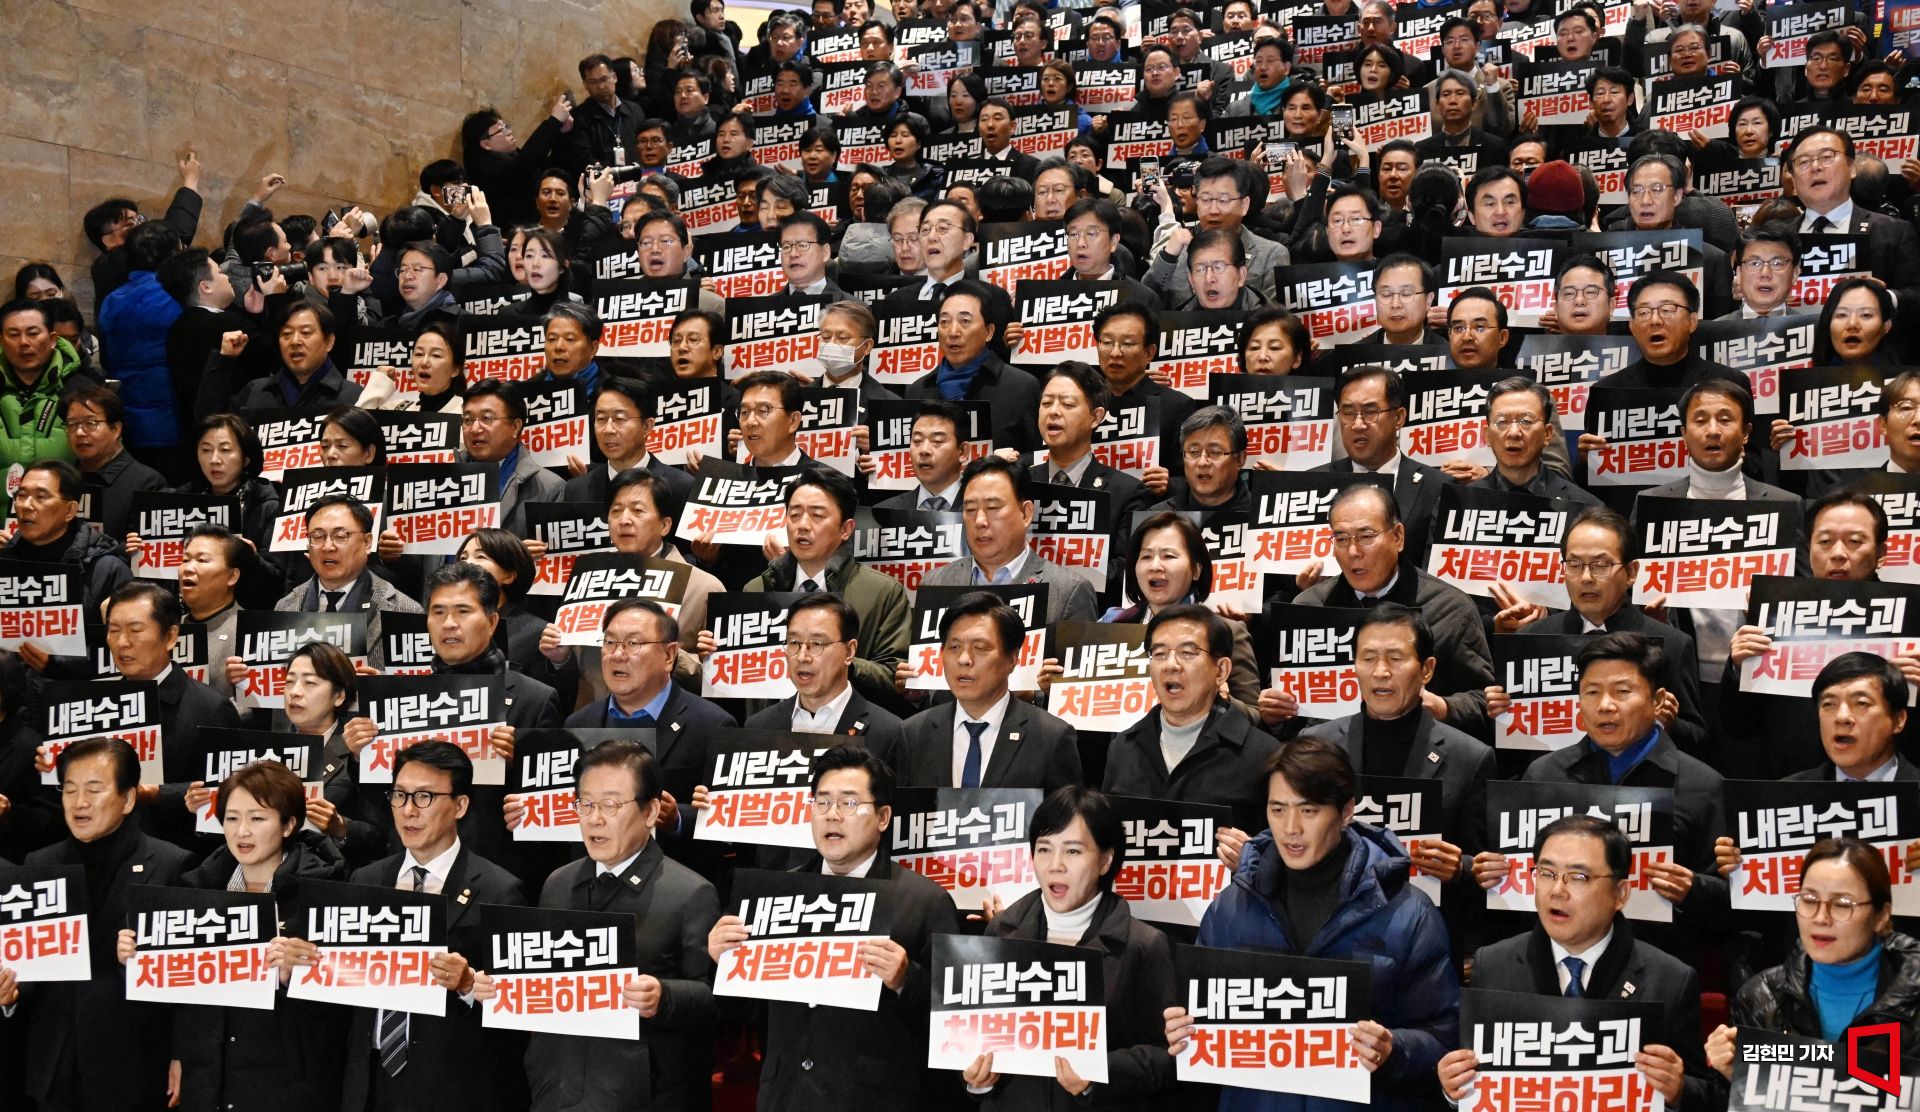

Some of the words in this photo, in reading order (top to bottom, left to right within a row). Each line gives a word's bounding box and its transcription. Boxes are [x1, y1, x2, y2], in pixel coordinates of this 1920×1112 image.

[901, 27, 948, 44] 내란수
[1497, 18, 1550, 42] 란수괴
[1772, 7, 1845, 38] 내란수괴
[827, 68, 866, 89] 내란수
[1075, 69, 1136, 88] 내란수괴
[826, 87, 865, 106] 처벌하
[1352, 93, 1420, 125] 내란수괴
[1656, 80, 1732, 113] 내란수괴
[837, 125, 884, 145] 내란수
[1217, 120, 1284, 149] 내란수괴
[1657, 105, 1731, 133] 처벌하라
[667, 139, 711, 164] 란수괴
[923, 137, 982, 160] 내란수괴
[1570, 148, 1627, 170] 내란수
[1700, 165, 1780, 195] 내란수괴
[713, 242, 781, 273] 내란수
[1447, 249, 1552, 283] 내란수괴
[1801, 243, 1856, 272] 수괴
[598, 288, 687, 320] 내란수괴
[731, 304, 820, 340] 내란수괴
[878, 314, 937, 343] 내란수
[1019, 323, 1098, 354] 처벌하
[1159, 322, 1243, 357] 내란수
[731, 334, 820, 370] 처벌하라
[876, 345, 942, 374] 처벌하
[525, 388, 575, 423] 수괴
[801, 398, 843, 426] 수괴
[1409, 382, 1492, 421] 내란수
[1790, 378, 1893, 423] 내란수
[381, 422, 447, 450] 란수괴
[520, 419, 584, 453] 하라!
[645, 417, 717, 453] 벌하라!
[1096, 407, 1145, 439] 수괴
[1246, 423, 1329, 455] 벌하라!
[1408, 419, 1489, 455] 처벌하
[1599, 404, 1681, 439] 내란수
[1790, 416, 1889, 459] 처벌하
[795, 430, 850, 458] 하라!
[1093, 445, 1154, 470] 하라!
[1597, 441, 1688, 475] 처벌하
[394, 473, 485, 511] 내란수괴
[1258, 491, 1338, 524] 내란수
[393, 506, 496, 545] 처벌하라!
[536, 518, 613, 550] 내란수
[688, 504, 787, 532] 처벌하라
[1444, 509, 1567, 544] 내란수괴
[1645, 513, 1778, 553] 내란수괴
[854, 522, 962, 558] 내란수괴
[1201, 523, 1248, 562] 수괴
[1253, 527, 1334, 560] 처벌하
[0, 574, 66, 604] 란수괴
[564, 568, 674, 601] 내란수괴
[1, 609, 78, 638] 벌하라!
[714, 609, 788, 647] 내란수
[1758, 597, 1906, 637] 내란수괴
[1063, 641, 1150, 678] 내란수
[1506, 656, 1578, 693] 내란
[48, 691, 146, 735] 내란수괴
[369, 687, 488, 731] 내란수괴
[1058, 681, 1158, 716] 처벌하
[522, 749, 579, 787] 내란
[712, 748, 827, 786] 내란수
[706, 791, 813, 828] 처벌하
[892, 802, 1025, 849] 내란수괴
[1354, 793, 1421, 830] 수괴
[1739, 796, 1898, 848] 내란수괴
[1122, 818, 1213, 856] 란수괴
[0, 878, 66, 920] 수괴
[1115, 864, 1224, 900] 벌하라!
[137, 905, 258, 946] 내란수괴
[307, 906, 430, 942] 내란수괴
[739, 893, 876, 936] 내란수괴
[4, 920, 81, 962] 하라!
[492, 926, 617, 969] 내란수괴
[136, 946, 269, 987] 처벌하라!
[302, 951, 437, 987] 처벌하라
[727, 942, 872, 981] 처벌하라
[943, 961, 1086, 1005] 내란수괴
[1188, 976, 1347, 1019] 내란수괴
[941, 1011, 1099, 1053] 처벌하라!
[1473, 1018, 1640, 1066] 내란수괴
[1475, 1074, 1655, 1112] 처벌하라!
